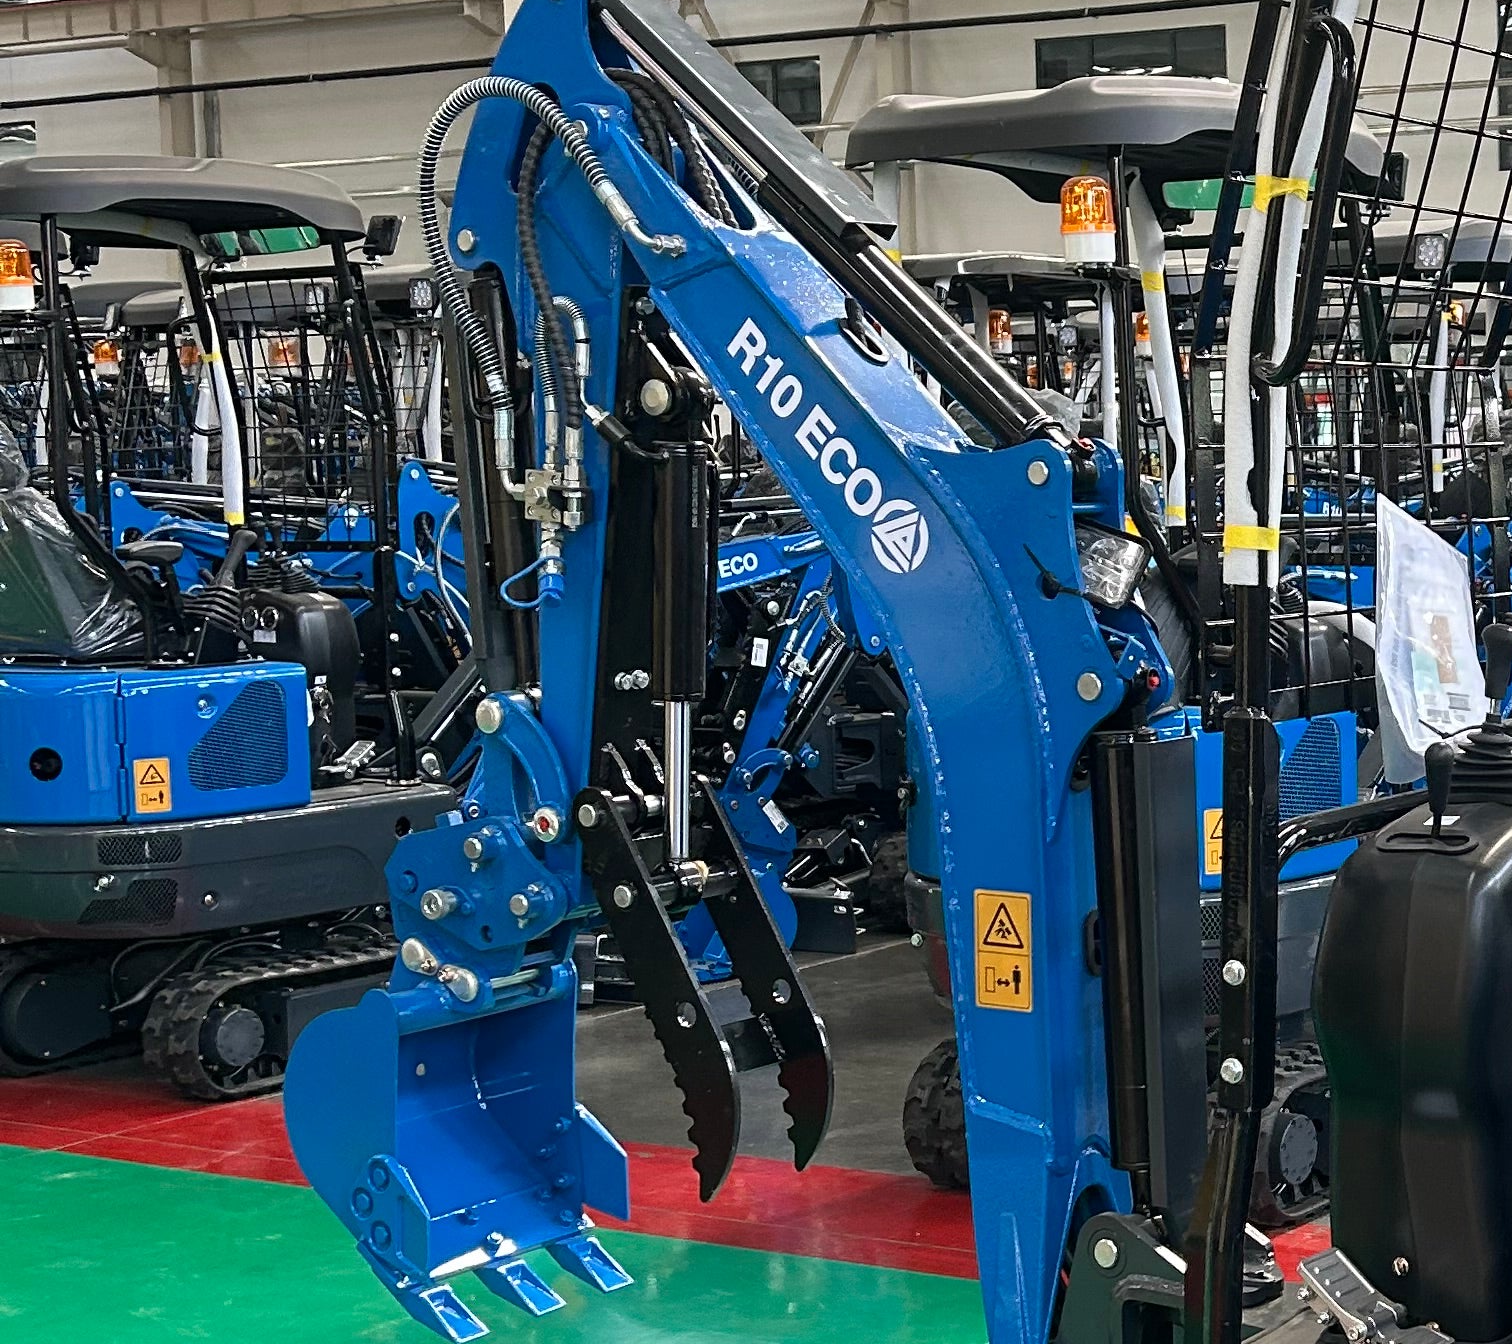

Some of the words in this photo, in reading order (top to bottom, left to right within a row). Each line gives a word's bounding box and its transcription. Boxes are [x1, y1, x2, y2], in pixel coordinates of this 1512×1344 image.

[727, 317, 804, 418] R10
[794, 404, 883, 517] ECO
[718, 552, 759, 579] ECO
